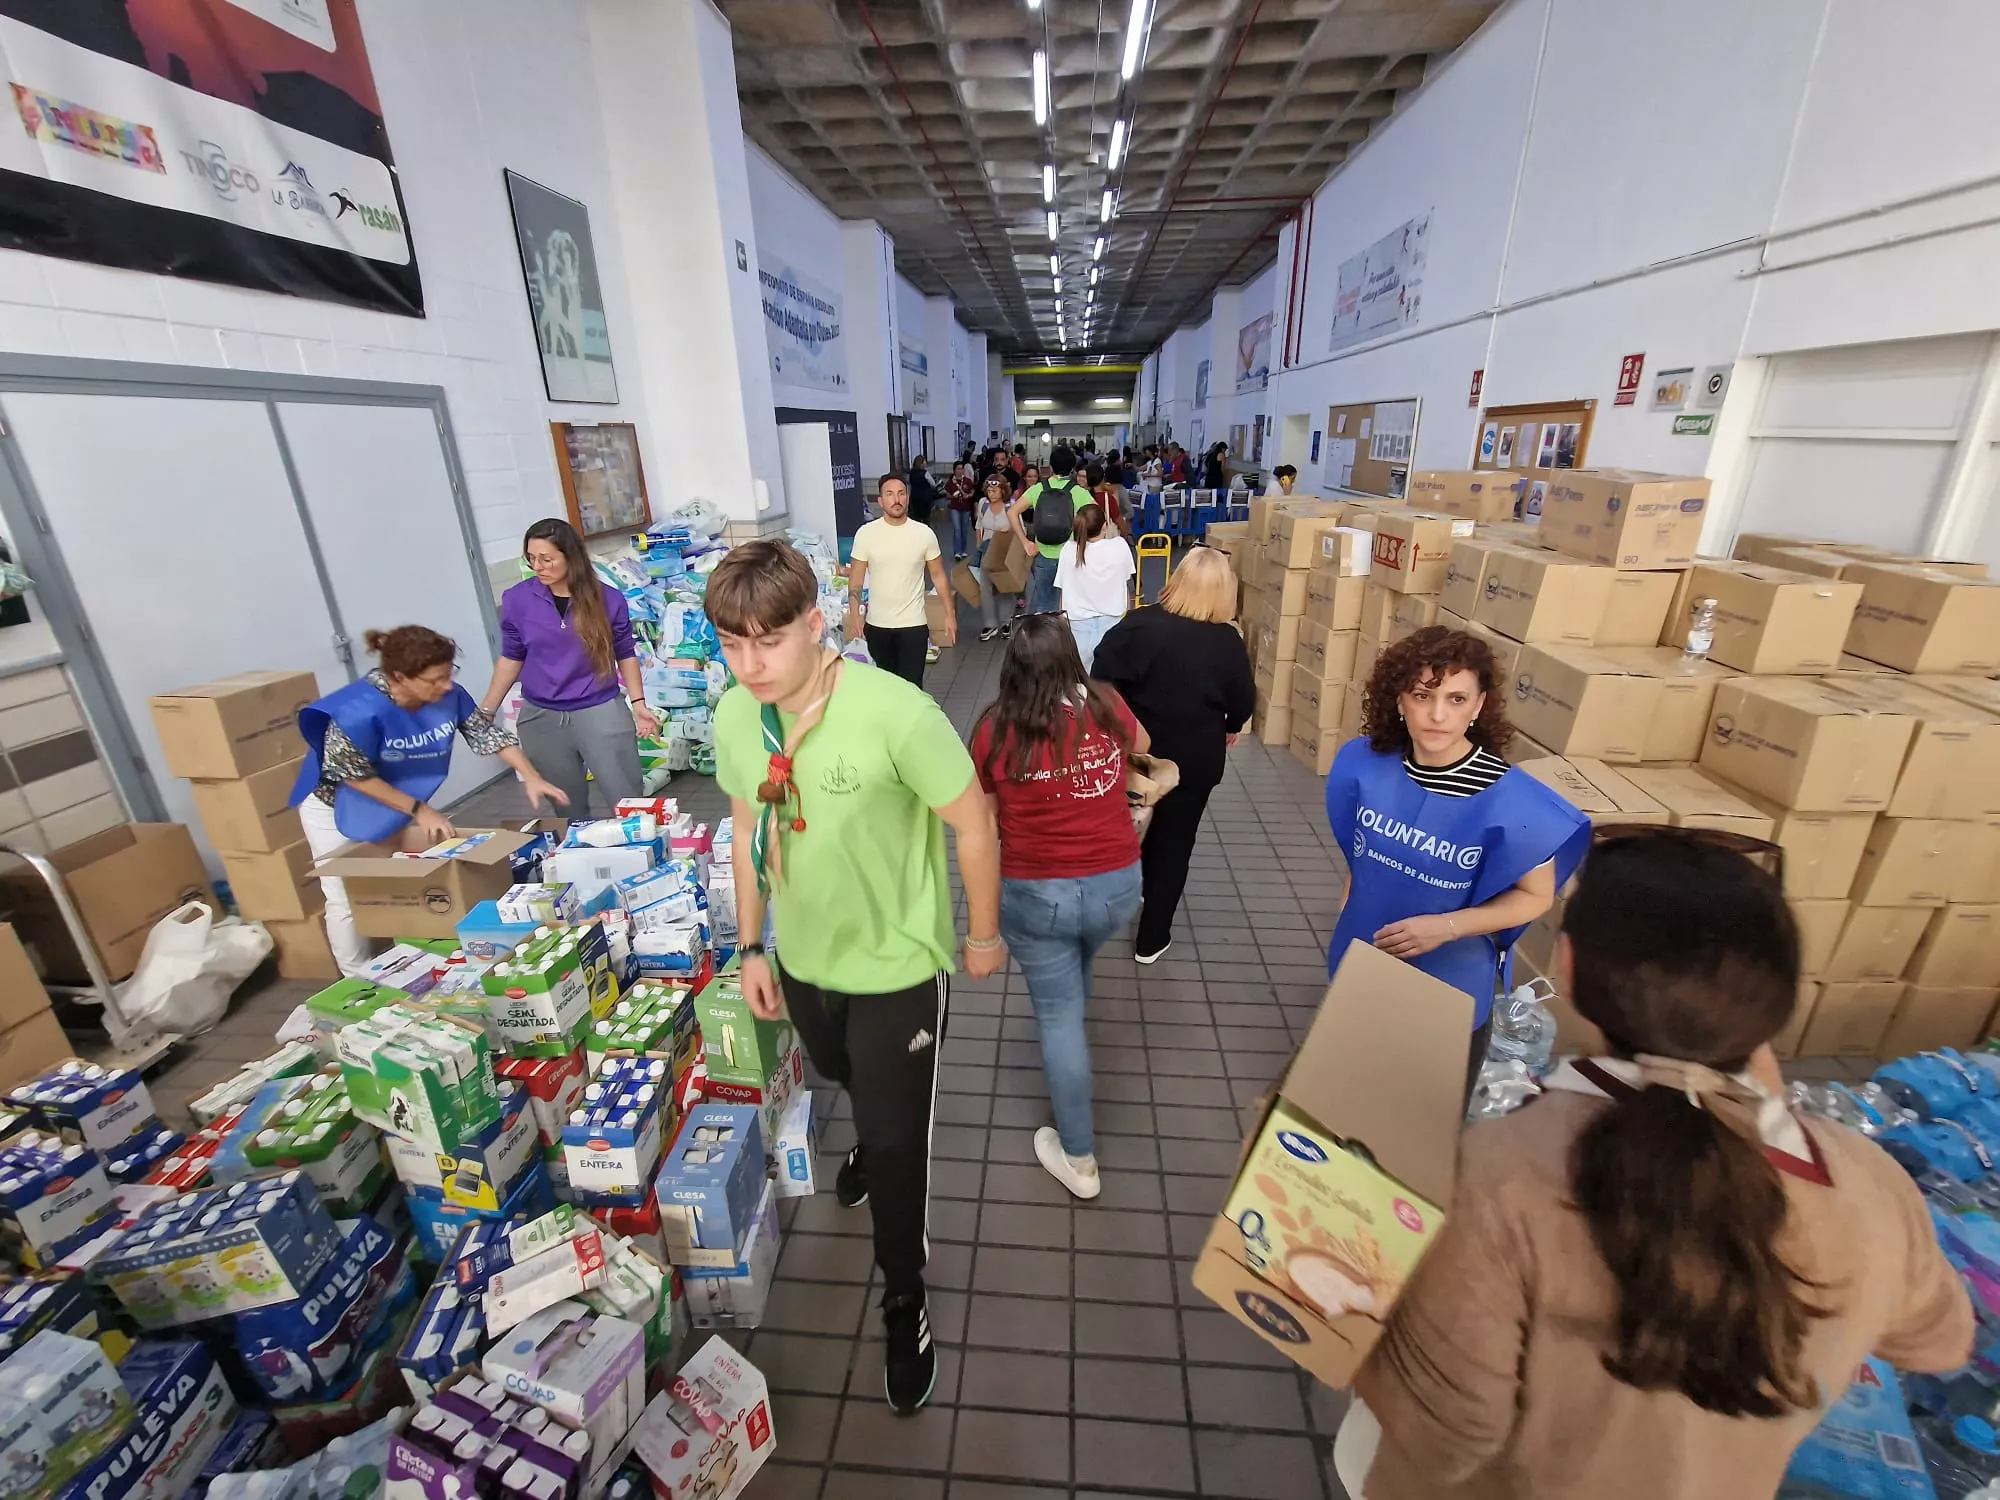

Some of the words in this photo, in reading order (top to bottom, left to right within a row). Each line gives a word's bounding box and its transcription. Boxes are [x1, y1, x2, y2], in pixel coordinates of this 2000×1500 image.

[1083, 758, 1107, 771] Ruta
[1356, 804, 1483, 870] VOLUNTARI@
[1367, 848, 1403, 871] BANCOS
[1405, 865, 1417, 877] DE
[1417, 872, 1473, 890] ALIMENTOS
[561, 981, 577, 998] SEMI
[507, 1008, 537, 1018] SEMI
[496, 1017, 557, 1028] DESNATADA
[716, 1085, 752, 1097] COVAP
[580, 1159, 624, 1170] ENTERA
[301, 1229, 384, 1326] PULEVA
[85, 1374, 197, 1500] PULEVA
